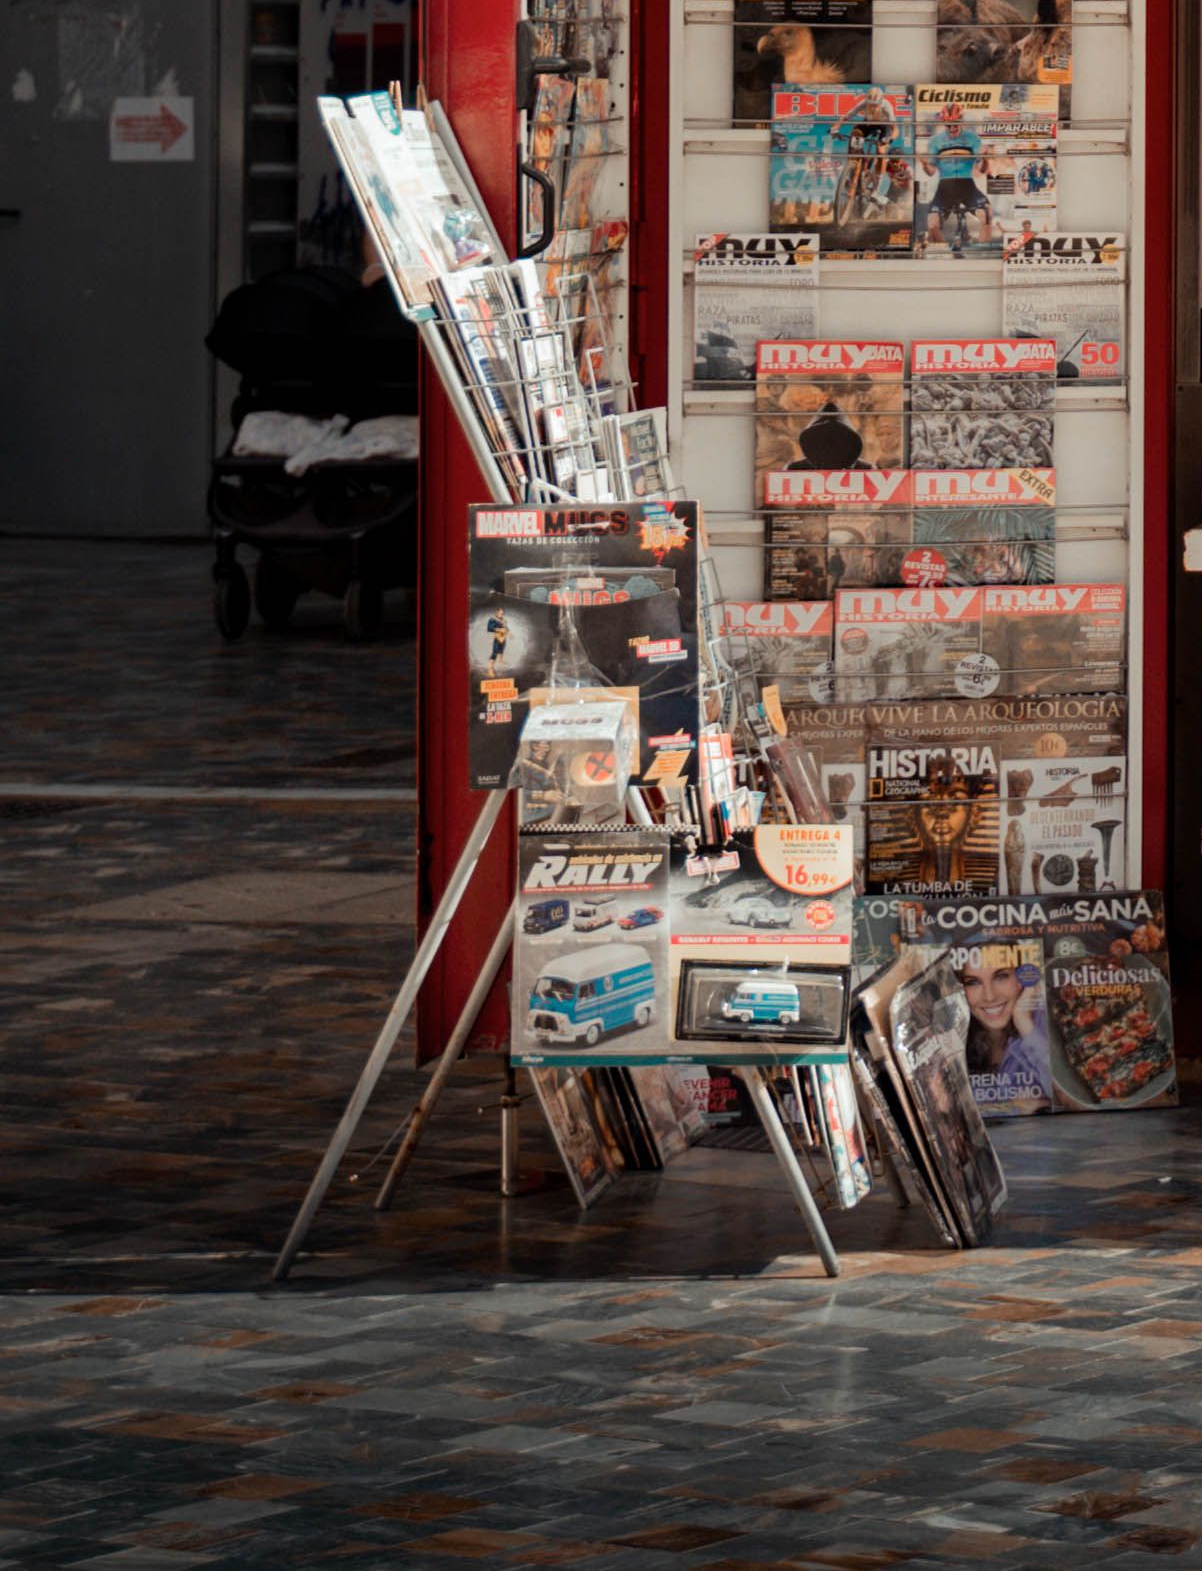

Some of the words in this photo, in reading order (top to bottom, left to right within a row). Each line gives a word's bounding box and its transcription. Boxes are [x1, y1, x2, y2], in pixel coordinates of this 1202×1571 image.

[919, 90, 991, 103] Ciclismo
[698, 259, 781, 267] HISTORIA
[1007, 257, 1088, 265] HISTORIA
[761, 344, 870, 369] muy
[915, 343, 1023, 367] muy
[1080, 342, 1120, 364] 50
[761, 362, 847, 370] HISTORIA
[915, 361, 1000, 369] HISTORIA
[768, 471, 909, 501] muy
[1019, 469, 1055, 499] EXTRA
[768, 493, 869, 502] HISTORIA
[915, 493, 1017, 501] INTERESANTE
[477, 511, 541, 536] MARVEL
[544, 509, 629, 536] MUGS
[506, 537, 535, 546] TAZAS
[536, 537, 548, 545] DE
[550, 536, 601, 545] COLECCIÓN
[922, 551, 932, 563] 2
[839, 589, 980, 619] muy
[985, 588, 1089, 611] muy
[985, 604, 1062, 612] HISTORIA
[839, 611, 940, 620] HISTORIA
[978, 655, 987, 664] 2
[873, 702, 924, 725] VIVE
[932, 701, 958, 723] LA
[966, 696, 1122, 724] ARQUEOLOGÍA
[884, 729, 897, 738] DE
[898, 729, 911, 738] LA
[912, 728, 941, 737] MANO
[945, 727, 957, 735] DE
[957, 727, 974, 735] LOS
[976, 725, 1013, 735] MEJORES
[1014, 723, 1058, 733] EXPERTOS
[1060, 721, 1109, 731] ESPAÑOLES
[1045, 766, 1081, 776] HISTORIA
[885, 779, 920, 788] NATIONAL
[885, 787, 932, 796] GEOGRAPHIC
[779, 829, 829, 841] ENTREGA
[834, 829, 841, 841] 4
[1053, 824, 1083, 838] PASADO
[522, 855, 660, 890] RALLY
[884, 884, 900, 895] LA
[904, 882, 952, 893] TUMBA
[954, 880, 973, 892] DE
[937, 903, 1048, 929] COCINA
[1049, 904, 1075, 919] más
[1075, 898, 1152, 922] SANA
[981, 925, 1035, 936] SABROSA
[1037, 925, 1045, 935] Y
[1047, 923, 1105, 934] NUTRITIVA
[1053, 963, 1162, 988] Deliciosas
[1076, 984, 1141, 997] VERDURAS
[1014, 1071, 1034, 1085] TU
